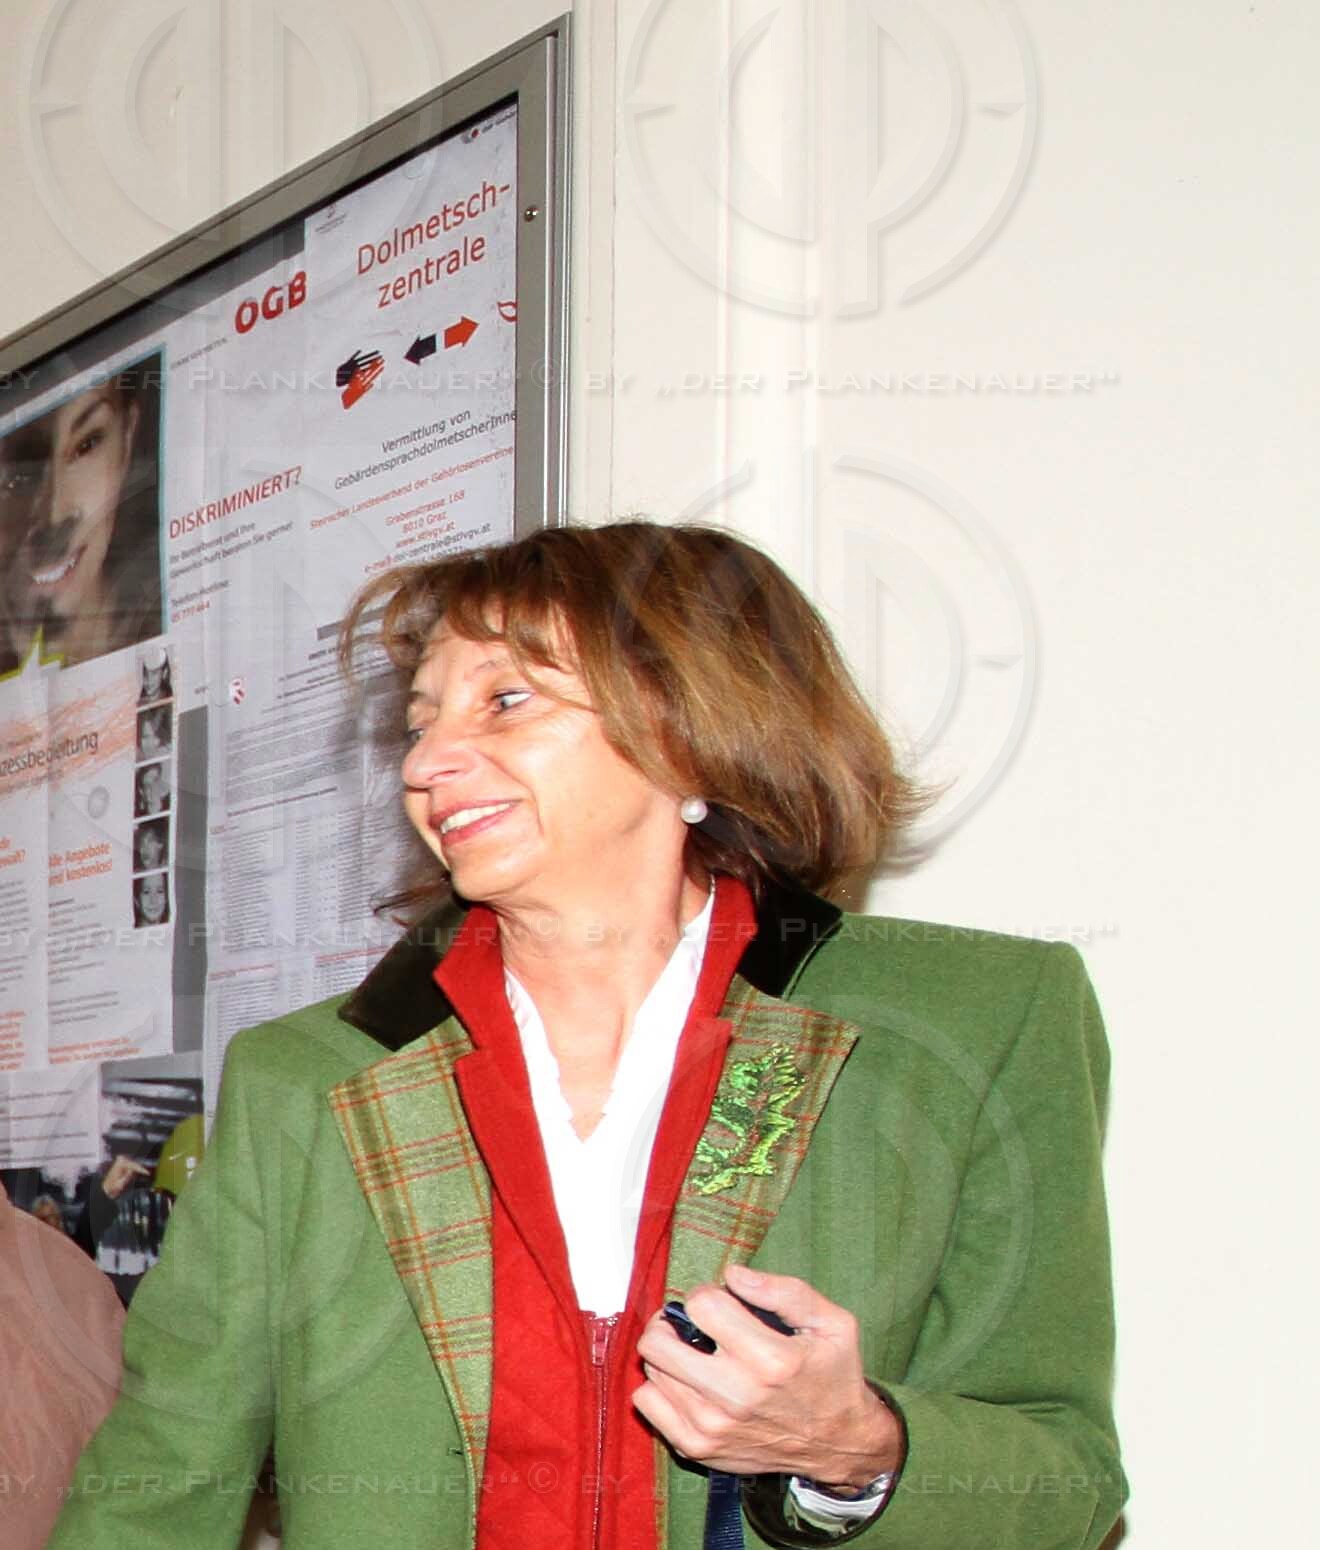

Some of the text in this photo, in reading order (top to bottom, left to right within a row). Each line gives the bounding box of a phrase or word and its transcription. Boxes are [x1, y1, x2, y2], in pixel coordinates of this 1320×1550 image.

[357, 180, 510, 275] Dolmetsch-
[377, 235, 486, 309] zentrale
[382, 410, 471, 453] Vermittlung von
[169, 464, 303, 539] DISKRIMINIERT?
